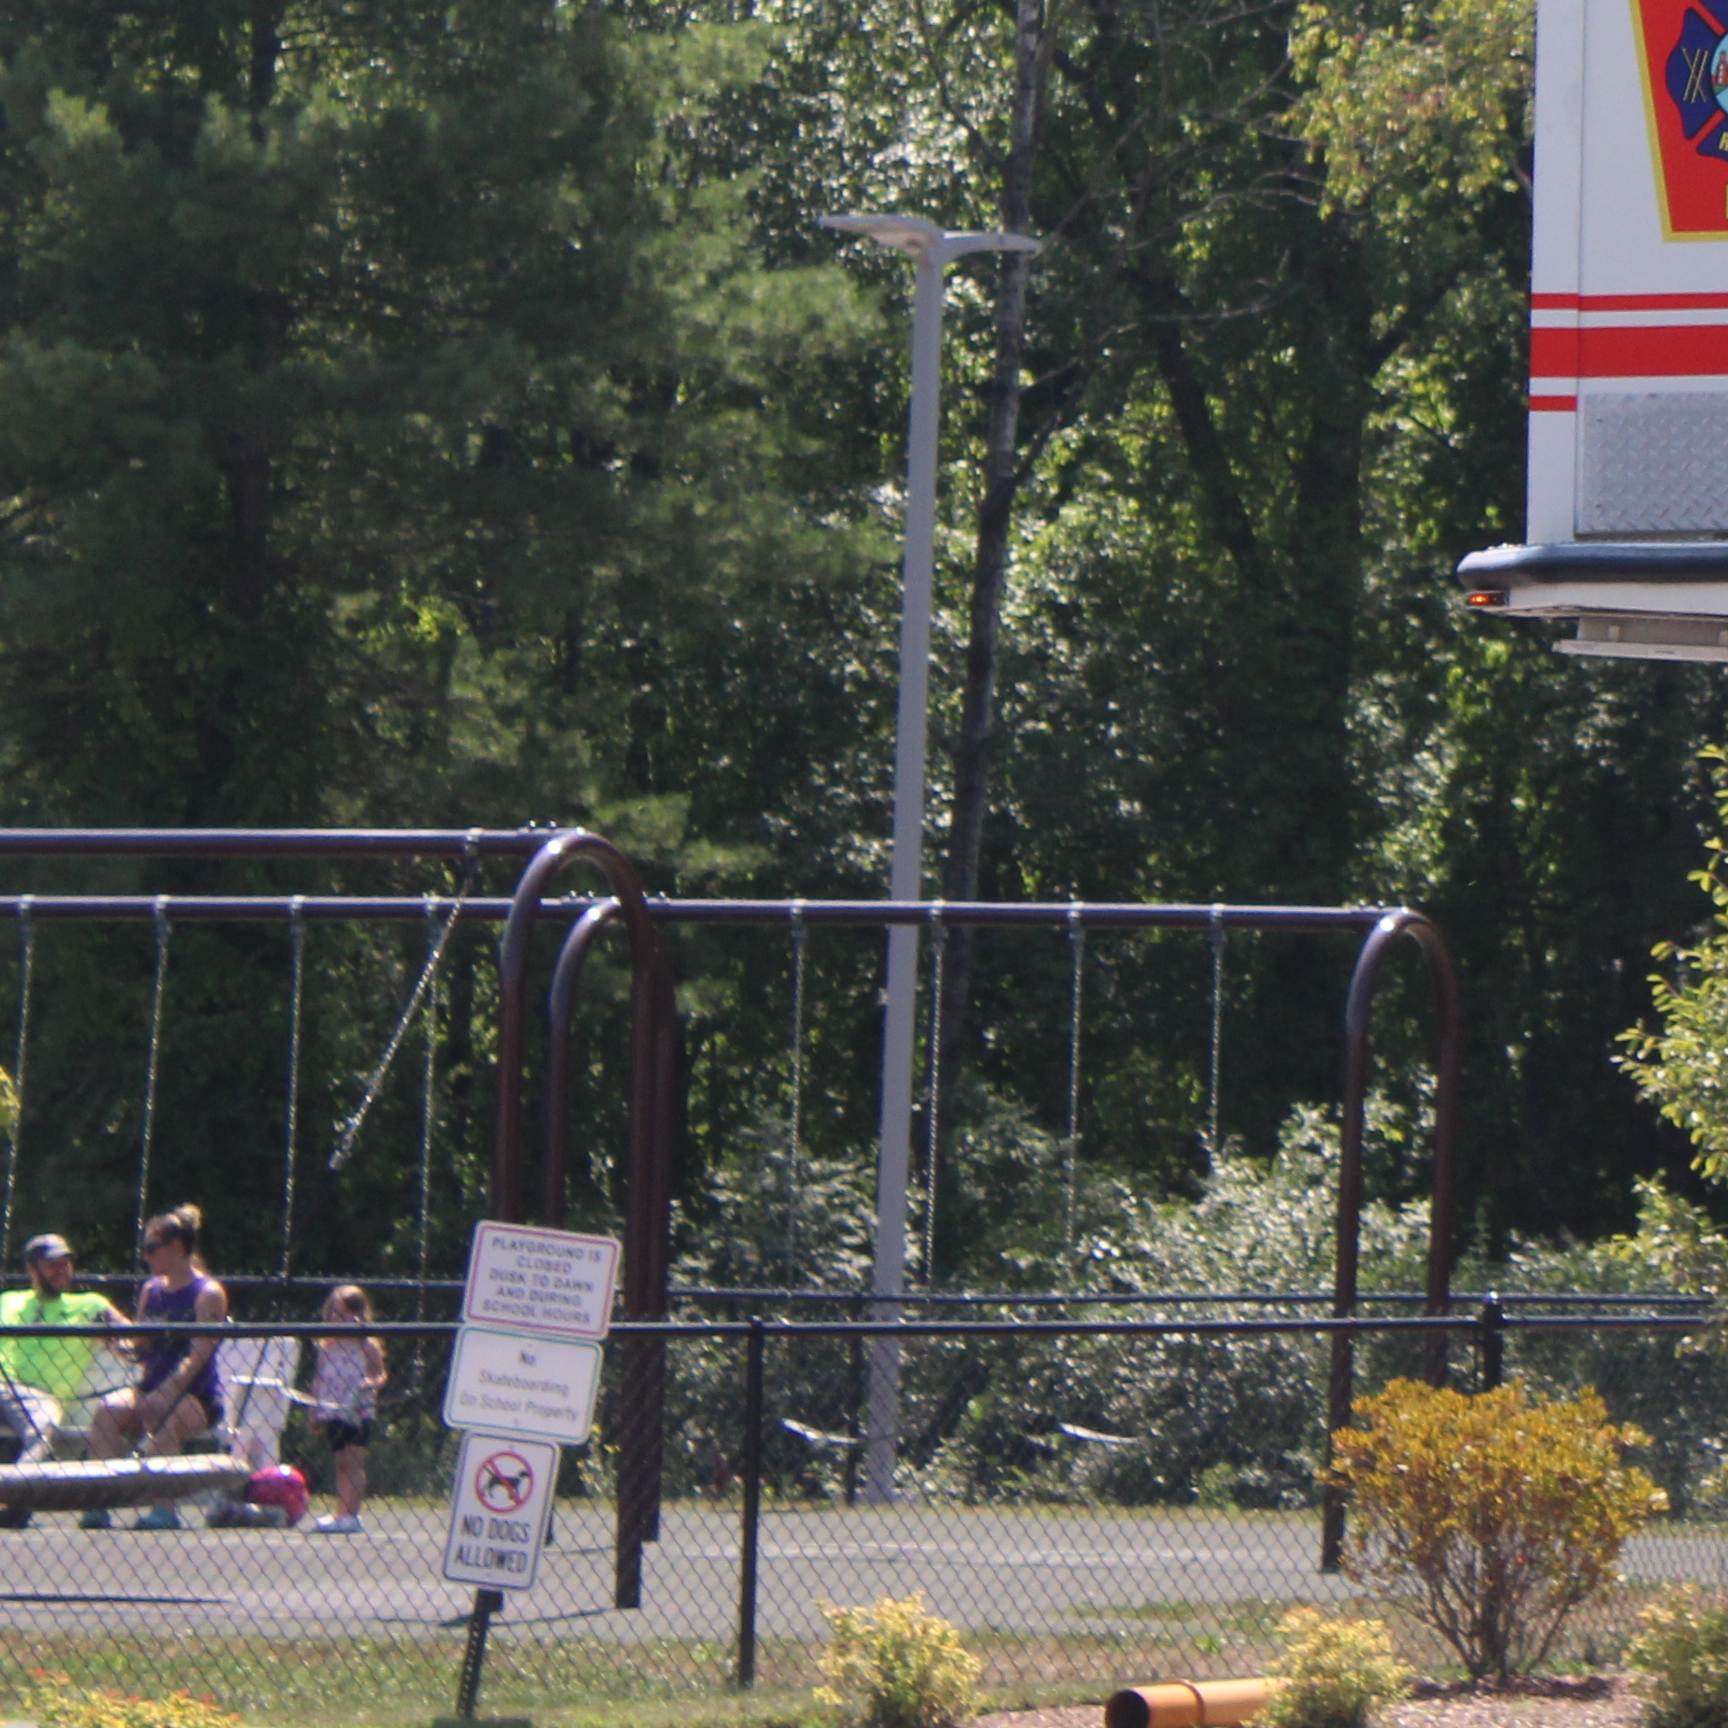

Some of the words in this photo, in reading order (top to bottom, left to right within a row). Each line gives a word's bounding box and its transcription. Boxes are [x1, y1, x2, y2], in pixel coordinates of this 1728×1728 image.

[492, 1236, 585, 1260] PLAYGROUND
[589, 1250, 601, 1262] IS
[517, 1255, 572, 1273] CLOSED
[489, 1267, 526, 1284] DUSK
[532, 1274, 549, 1287] TO
[553, 1276, 594, 1292] DAWN
[498, 1285, 525, 1299] AND
[529, 1289, 581, 1306] DURING
[482, 1298, 535, 1317] SCHOOL
[543, 1308, 590, 1322] HOURS
[520, 1350, 536, 1365] No
[479, 1370, 569, 1396] Skateboarding
[480, 1394, 522, 1411] School
[525, 1400, 578, 1421] Property
[461, 1514, 484, 1537] NO
[488, 1518, 531, 1543] DOGS
[454, 1544, 528, 1573] ALLOWED
